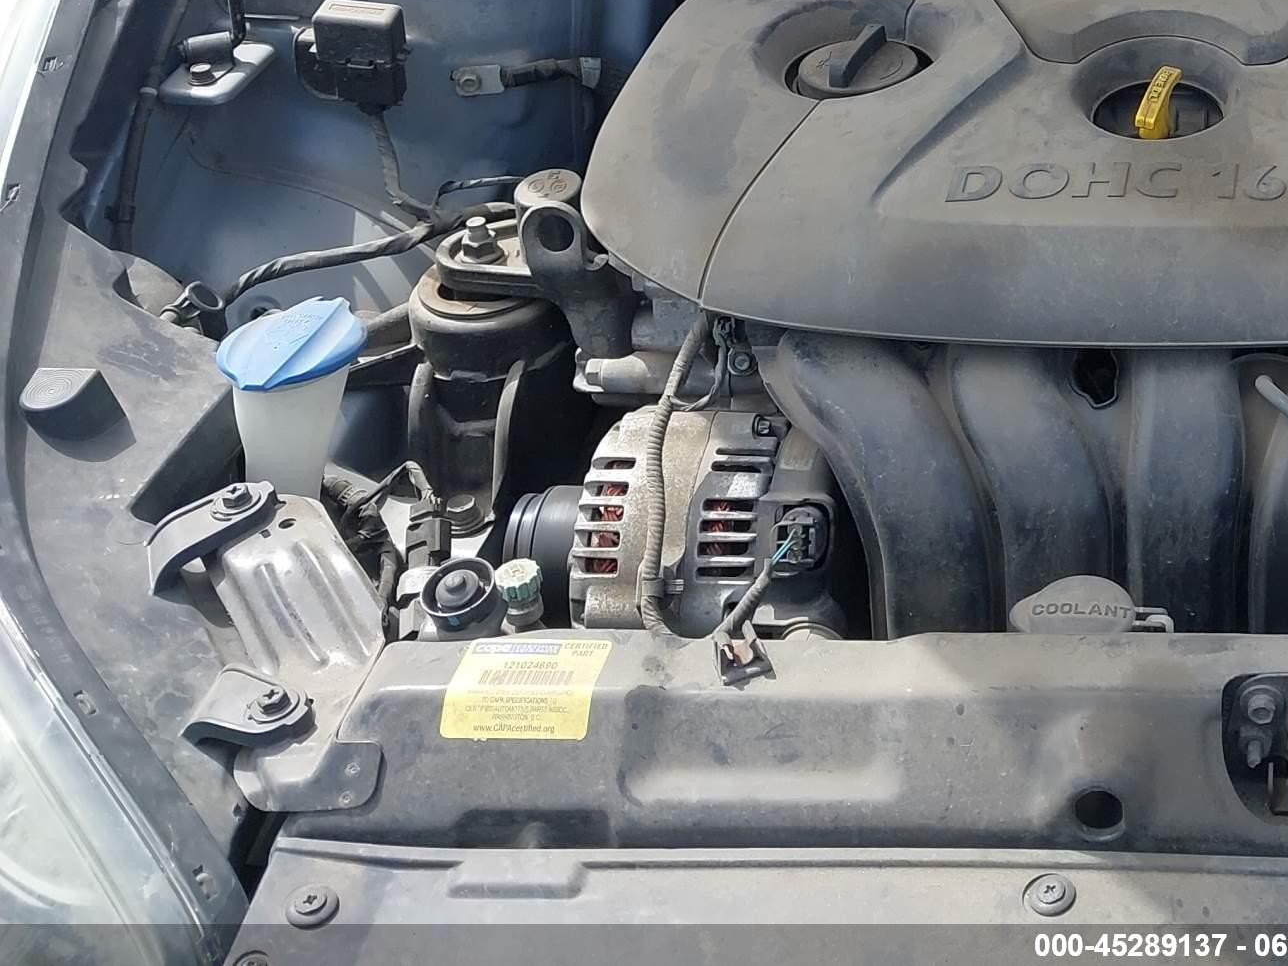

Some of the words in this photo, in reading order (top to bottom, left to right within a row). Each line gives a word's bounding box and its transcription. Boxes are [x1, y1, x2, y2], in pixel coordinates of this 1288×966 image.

[945, 161, 1183, 203] DOHC
[1031, 602, 1132, 619] COOLANT
[564, 642, 609, 651] CERTIFIED
[571, 650, 594, 658] PART
[473, 724, 555, 734] www.CAPAcertified.org
